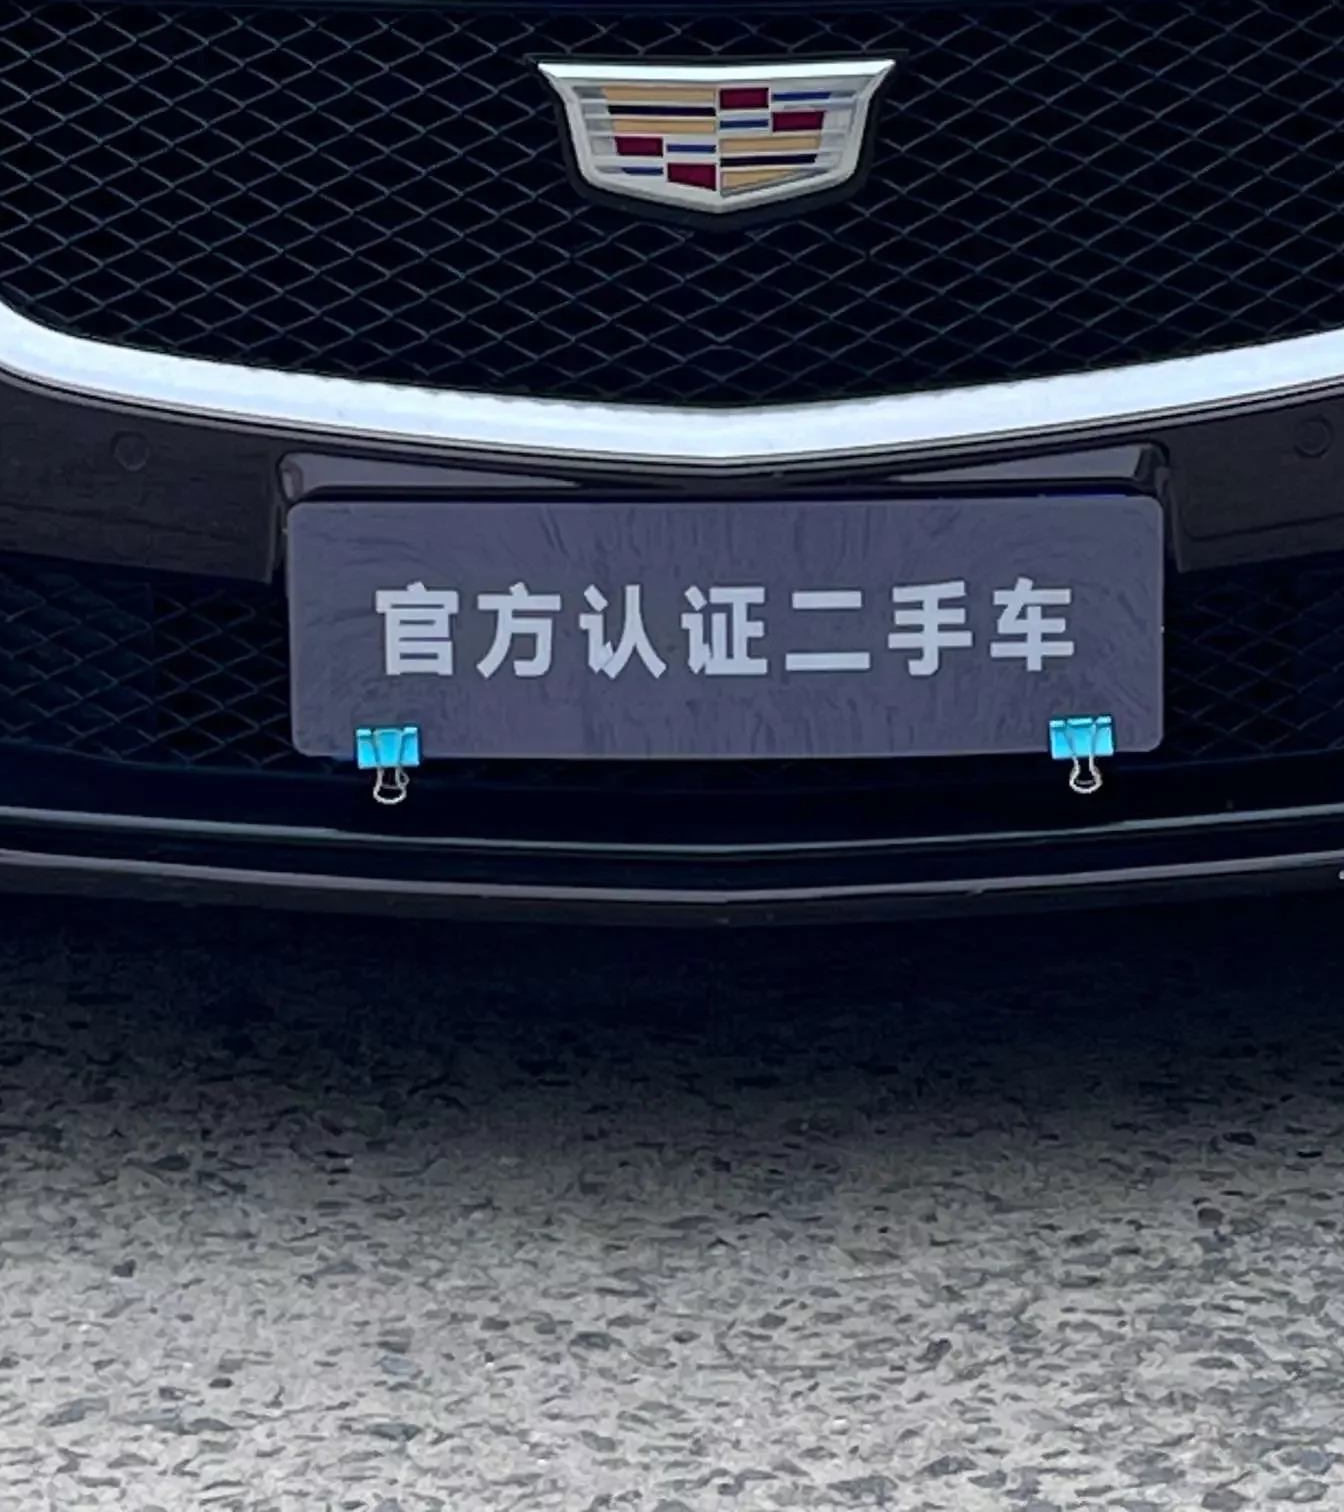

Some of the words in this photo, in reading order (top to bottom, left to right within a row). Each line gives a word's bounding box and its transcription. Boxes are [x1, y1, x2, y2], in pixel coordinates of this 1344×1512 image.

[375, 576, 1075, 679] 官方认证二手车
